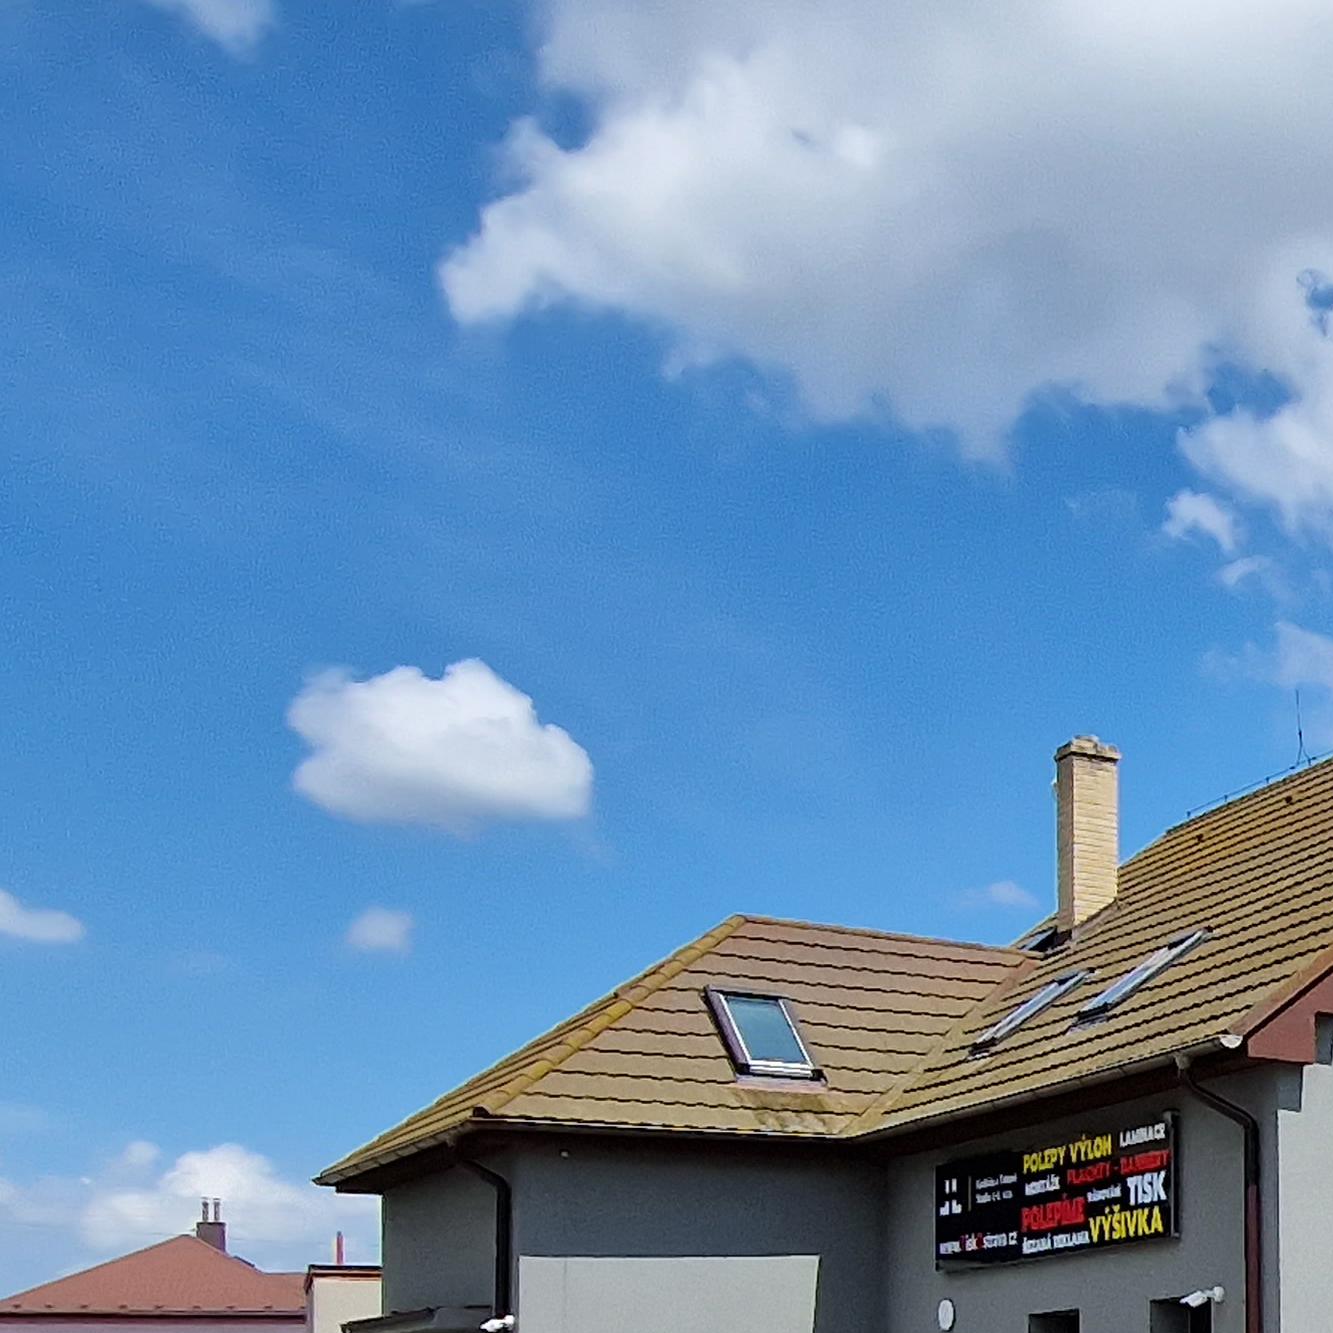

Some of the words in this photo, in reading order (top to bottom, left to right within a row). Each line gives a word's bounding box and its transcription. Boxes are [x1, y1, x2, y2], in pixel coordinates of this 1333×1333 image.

[1023, 1144, 1067, 1174] POLEPY
[1069, 1134, 1112, 1163] VÝLOH
[1126, 1170, 1167, 1206] TISK
[1089, 1204, 1163, 1243] VÝŠIVKA
